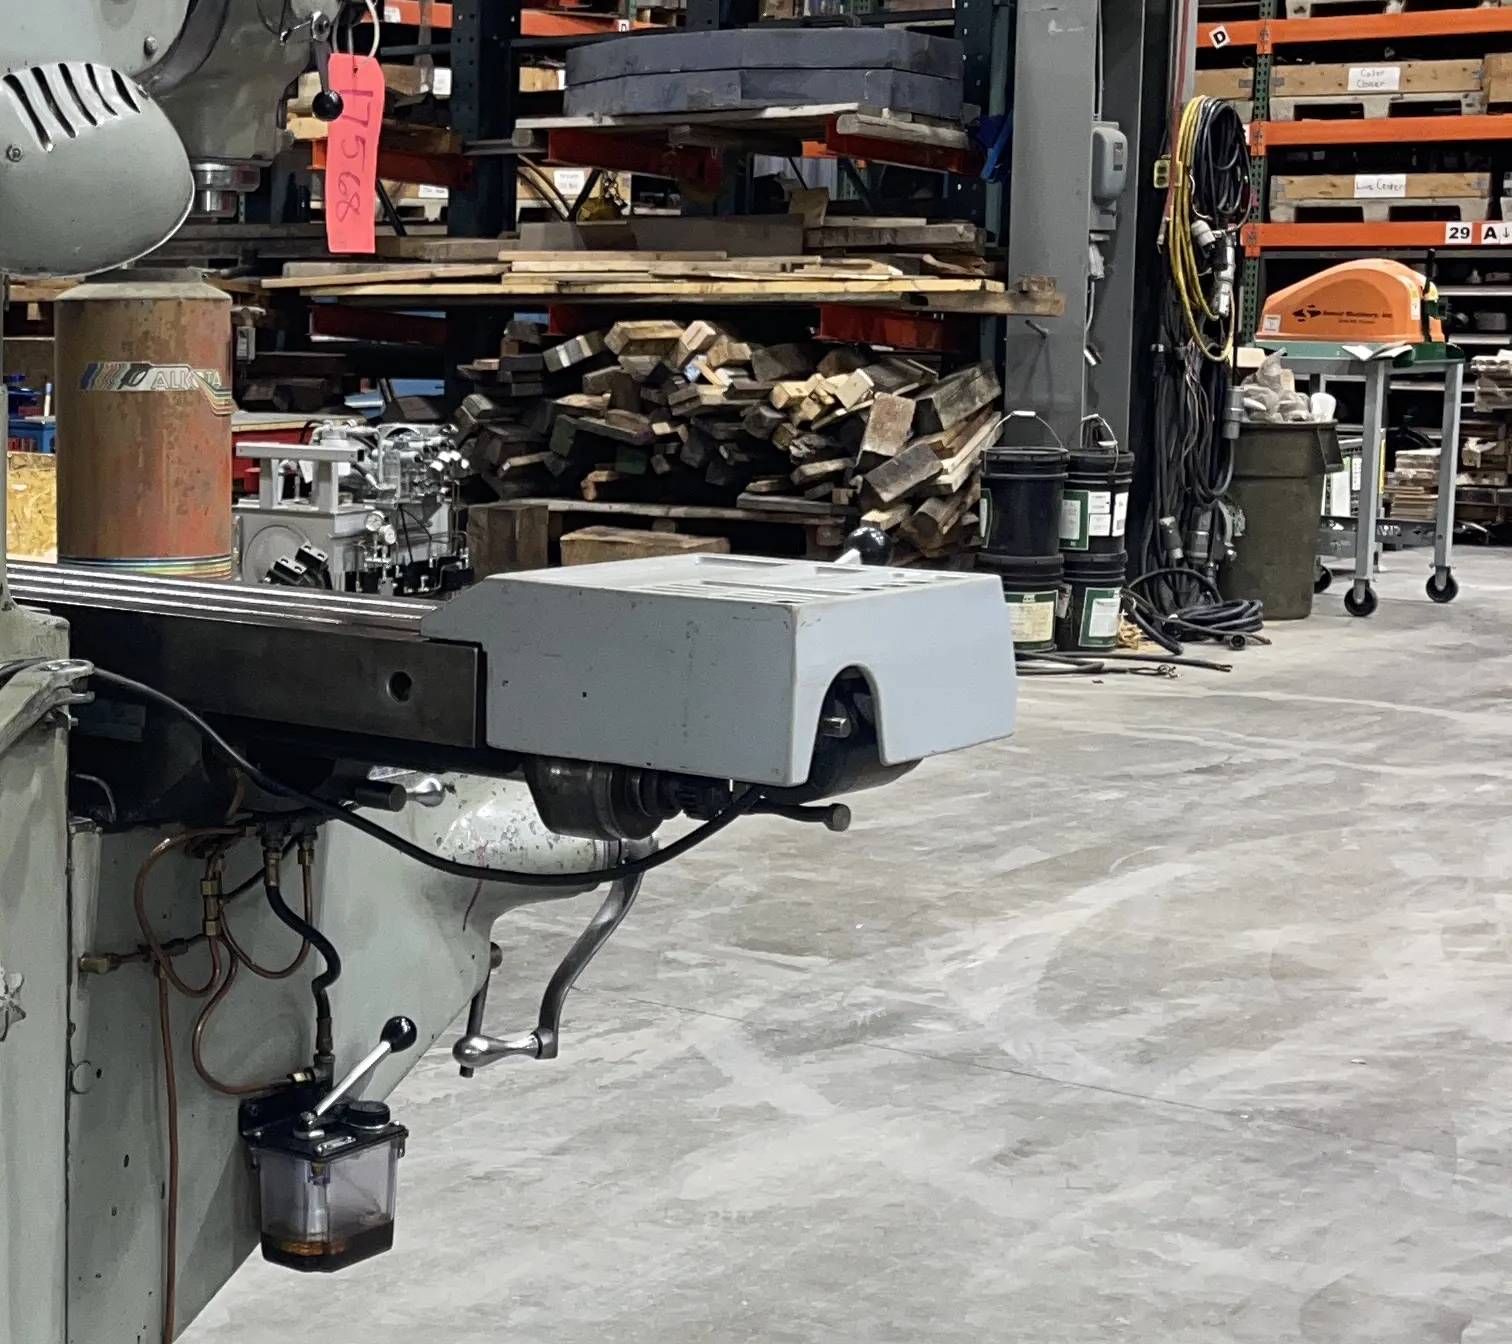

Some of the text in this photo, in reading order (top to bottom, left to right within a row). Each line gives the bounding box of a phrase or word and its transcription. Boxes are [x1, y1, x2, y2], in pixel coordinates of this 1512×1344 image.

[1213, 30, 1226, 44] D
[336, 89, 374, 223] 17568
[1449, 226, 1498, 240] 29 A
